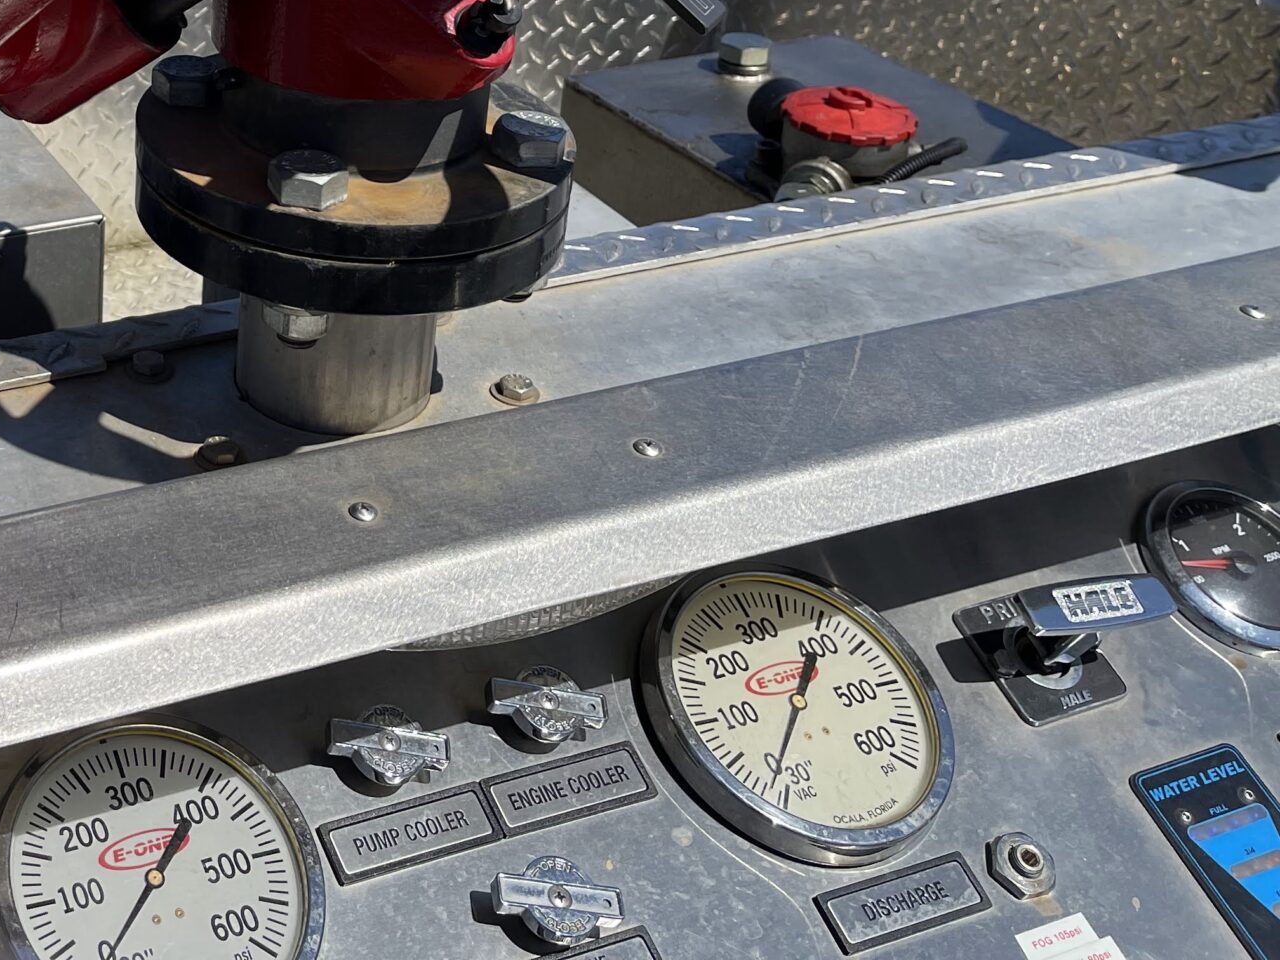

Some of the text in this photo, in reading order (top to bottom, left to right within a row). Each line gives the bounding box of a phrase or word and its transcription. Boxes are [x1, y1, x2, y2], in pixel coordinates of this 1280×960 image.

[1232, 523, 1246, 536] 2
[1178, 539, 1191, 552] 1
[735, 617, 779, 645] 300
[798, 633, 838, 658] 400
[705, 650, 750, 680] 200
[832, 678, 878, 708] 500
[1060, 689, 1094, 709] HALE
[717, 701, 759, 730] 100
[853, 725, 896, 756] 600
[764, 752, 783, 776] 0
[880, 760, 897, 777] psi
[104, 776, 154, 811] 300
[506, 764, 631, 811] ENGINE COOLER
[793, 785, 818, 802] VAC
[1149, 760, 1246, 803] WATER LEVEL
[172, 795, 220, 826] 400
[867, 797, 899, 819] FLORIDA
[1208, 804, 1229, 815] FULL
[59, 817, 109, 852] 200
[352, 809, 470, 855] PUMP COOLER
[202, 848, 251, 884] 500
[539, 858, 571, 873] OPEN
[57, 877, 105, 915] 100
[861, 881, 950, 922] DISCHARGE
[210, 905, 260, 942] 600
[544, 915, 588, 934] CLOSE
[1031, 927, 1082, 950] FOG 105psi
